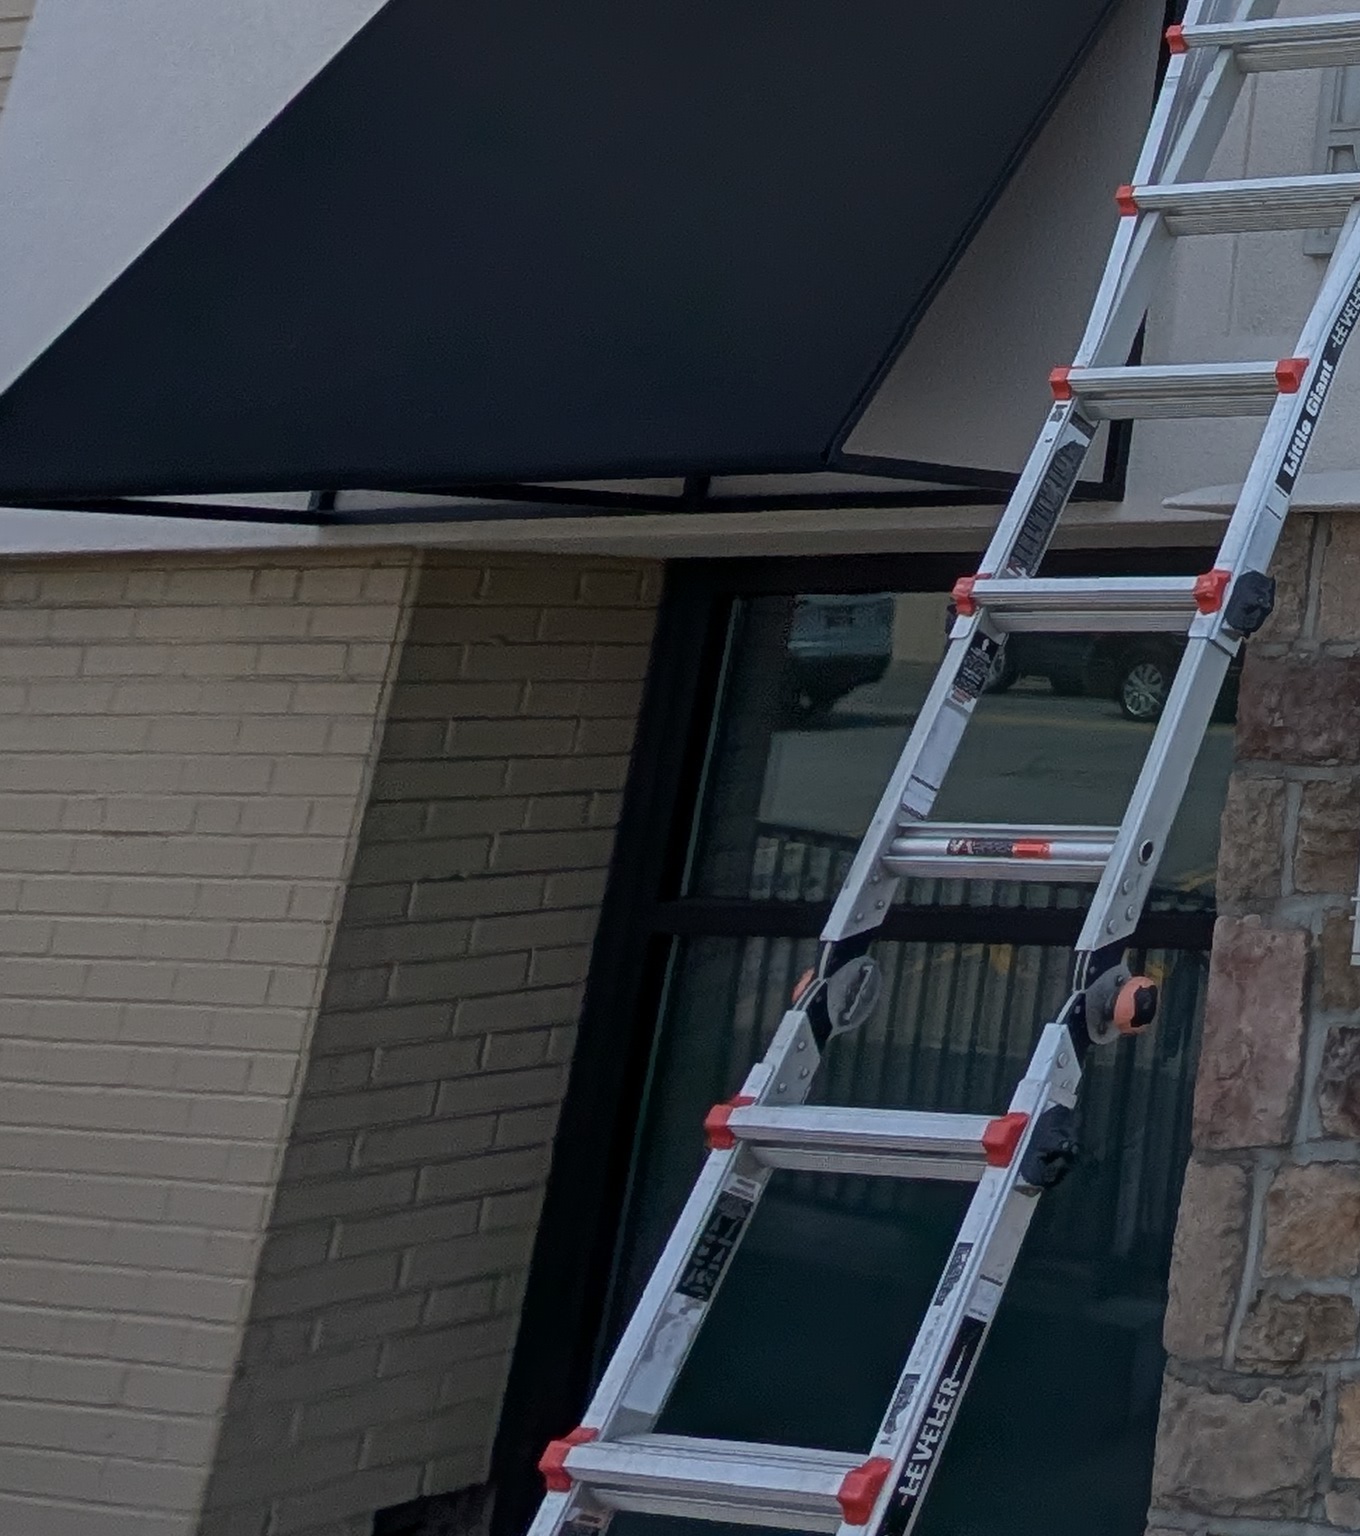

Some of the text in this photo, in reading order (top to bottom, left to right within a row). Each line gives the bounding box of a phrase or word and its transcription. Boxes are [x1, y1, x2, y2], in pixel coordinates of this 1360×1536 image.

[1283, 419, 1312, 477] Little
[1305, 360, 1333, 417] Giant
[898, 1376, 960, 1497] LEVELER
